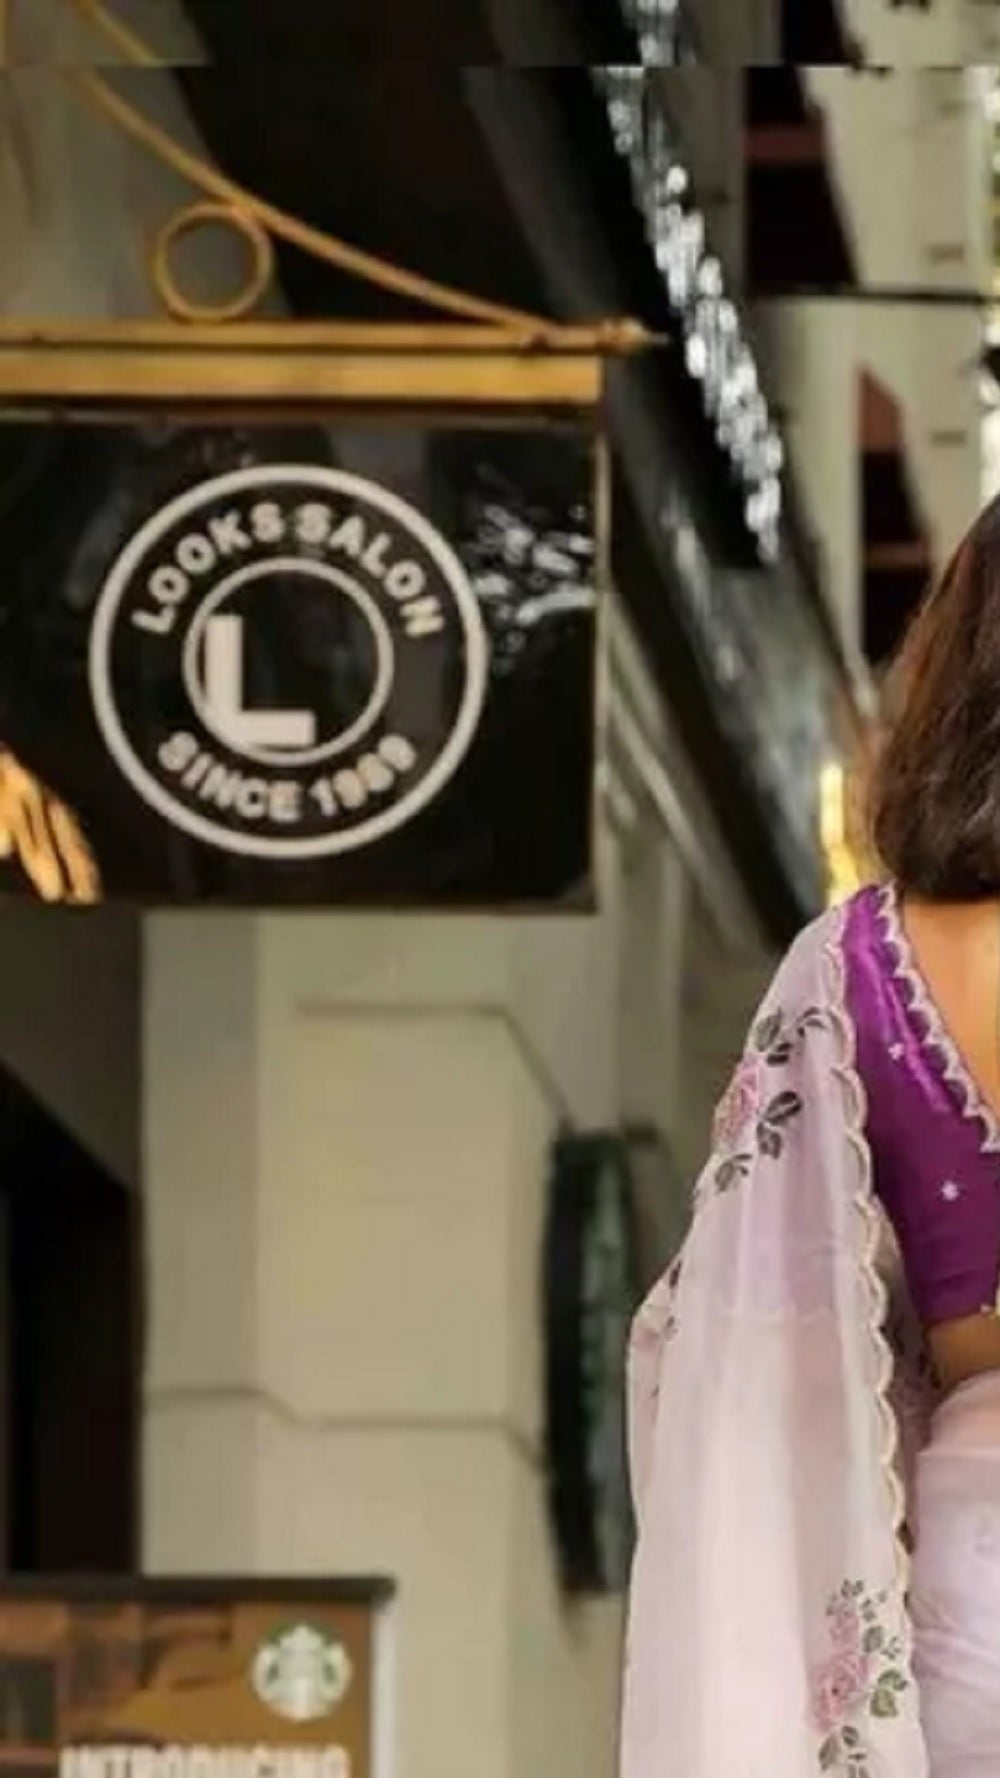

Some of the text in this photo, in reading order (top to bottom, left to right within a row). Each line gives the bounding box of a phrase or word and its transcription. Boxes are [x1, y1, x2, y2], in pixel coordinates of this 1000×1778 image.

[131, 502, 444, 638] LOOKS SALON
[204, 615, 316, 746] L
[158, 731, 301, 823] SINCE
